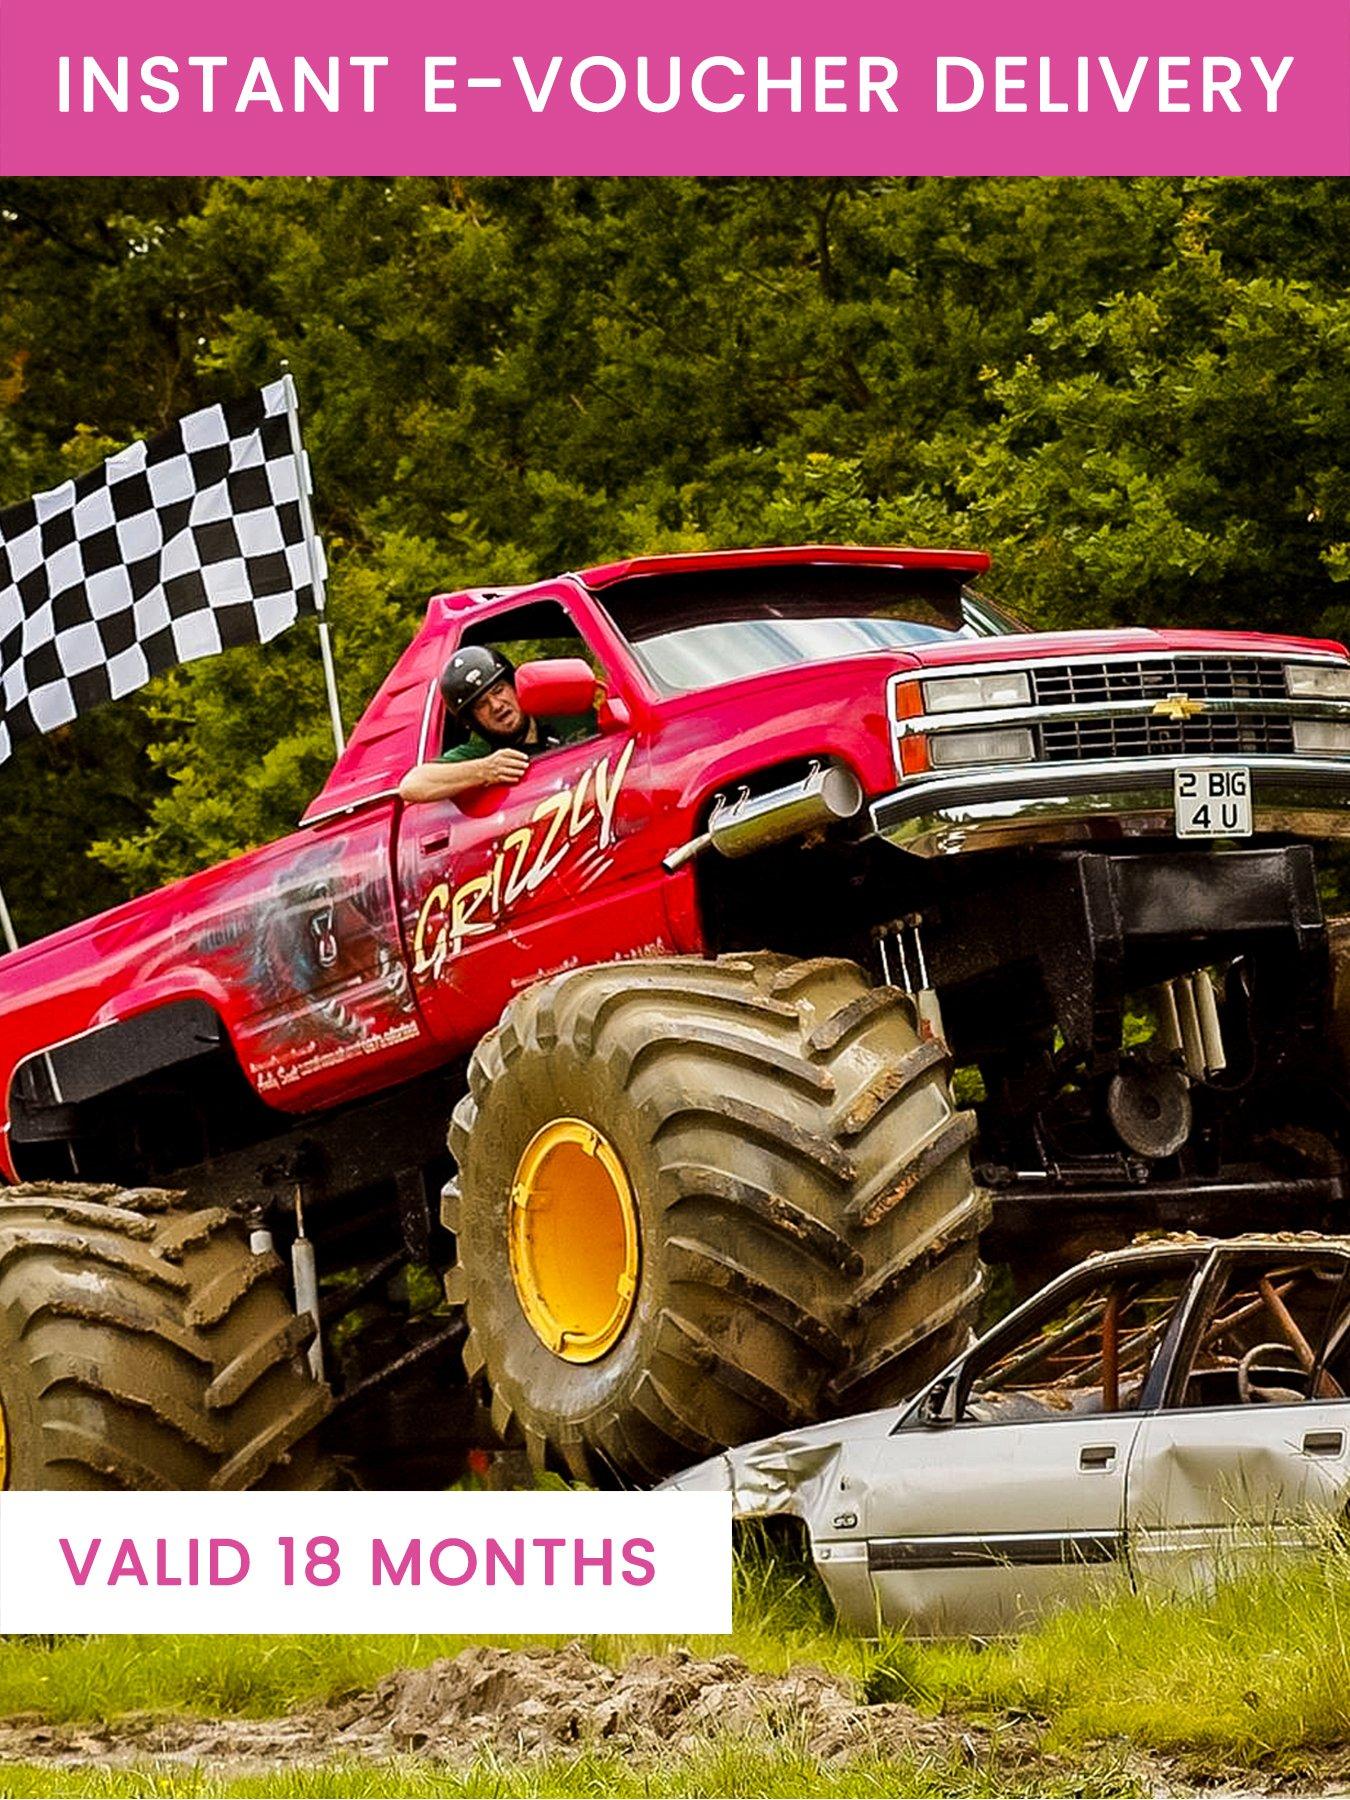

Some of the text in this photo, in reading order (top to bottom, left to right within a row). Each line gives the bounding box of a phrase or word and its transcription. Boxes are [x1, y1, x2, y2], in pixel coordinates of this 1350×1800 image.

[1178, 771, 1246, 798] 2 BIG
[1192, 803, 1238, 829] 4 U
[413, 738, 635, 980] GRIZZLY
